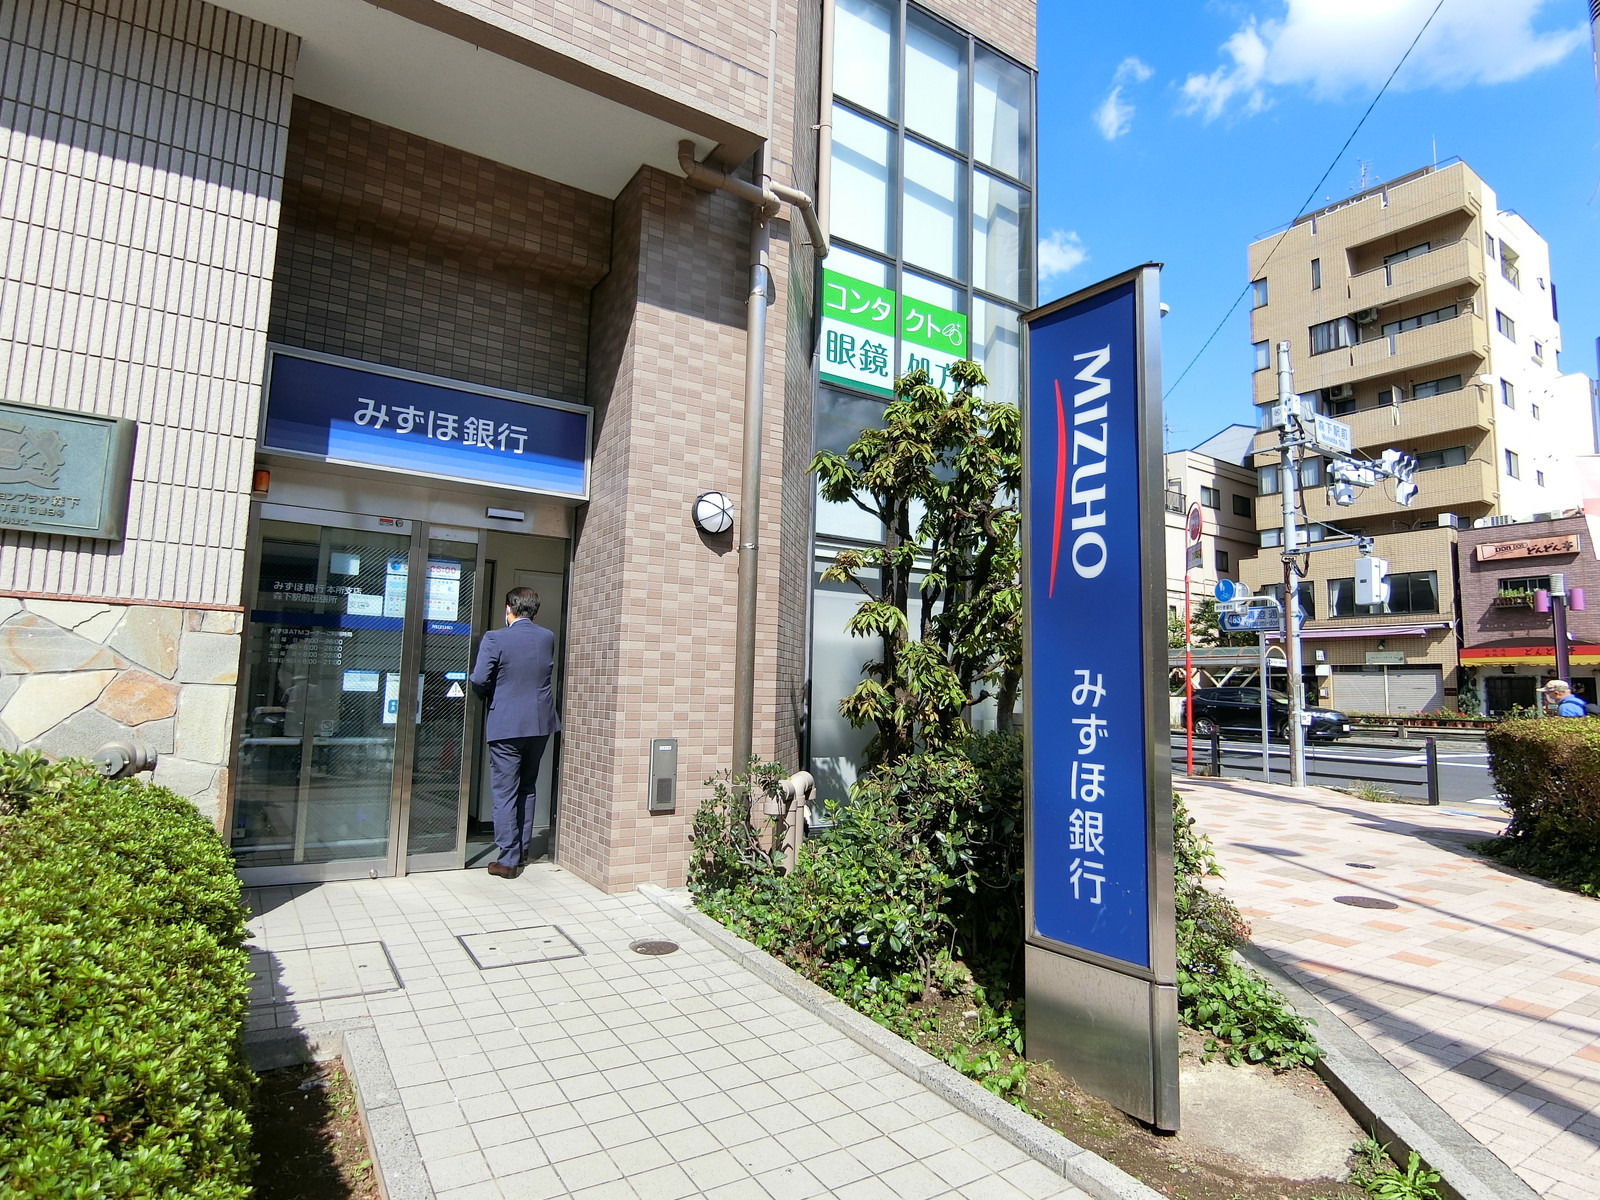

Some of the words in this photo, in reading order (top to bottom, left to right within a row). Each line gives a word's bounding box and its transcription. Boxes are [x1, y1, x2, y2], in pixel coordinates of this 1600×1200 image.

[825, 281, 941, 339] コンタクト
[353, 397, 528, 454] みずほ銀行
[1318, 419, 1348, 441] 森下駅前
[1071, 343, 1111, 579] MIZUHO
[51, 495, 81, 509] 森下
[1526, 540, 1574, 555] どんどん亭
[273, 581, 324, 593] みずほ銀行
[272, 592, 338, 604] 森下駅前出張所
[1227, 615, 1241, 625] 463
[1246, 608, 1278, 620] 清澄通
[1525, 646, 1576, 656] どんど亭
[1068, 669, 1109, 905] みずほ銀行
